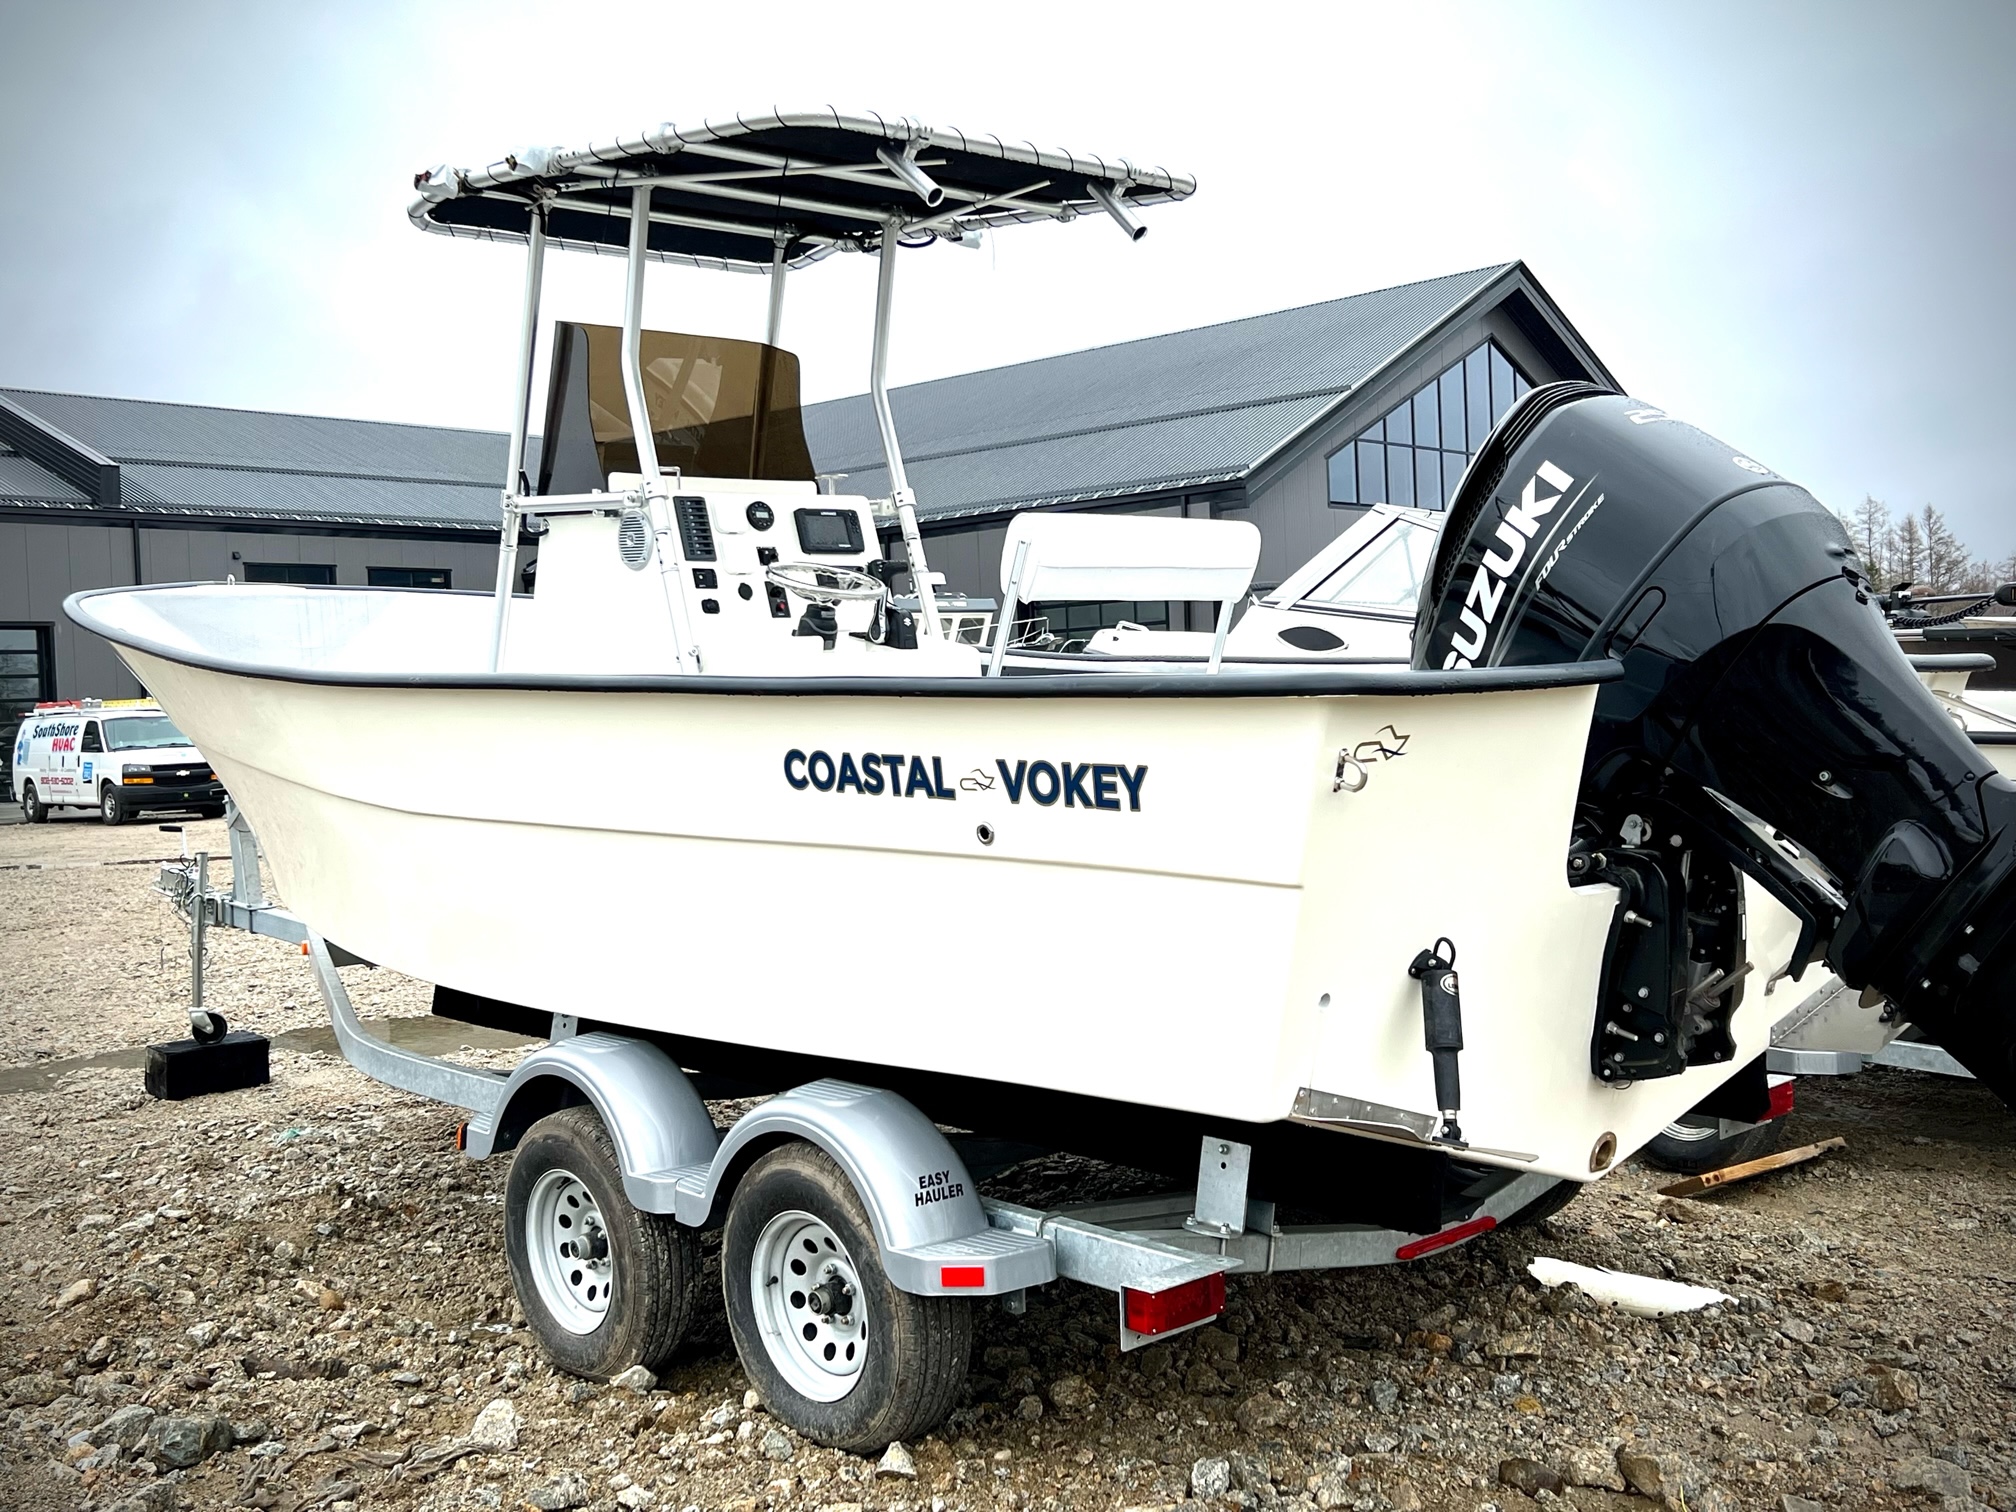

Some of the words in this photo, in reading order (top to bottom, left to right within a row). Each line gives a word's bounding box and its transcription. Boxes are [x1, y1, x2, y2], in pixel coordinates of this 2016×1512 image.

[1535, 538, 1567, 592] FOUR
[1566, 493, 1605, 545] STROKE
[52, 737, 76, 751] HVAC
[784, 748, 956, 801] COASTAL
[996, 758, 1149, 812] VOKEY
[919, 1170, 949, 1189] EASY
[915, 1183, 964, 1207] HAULER
